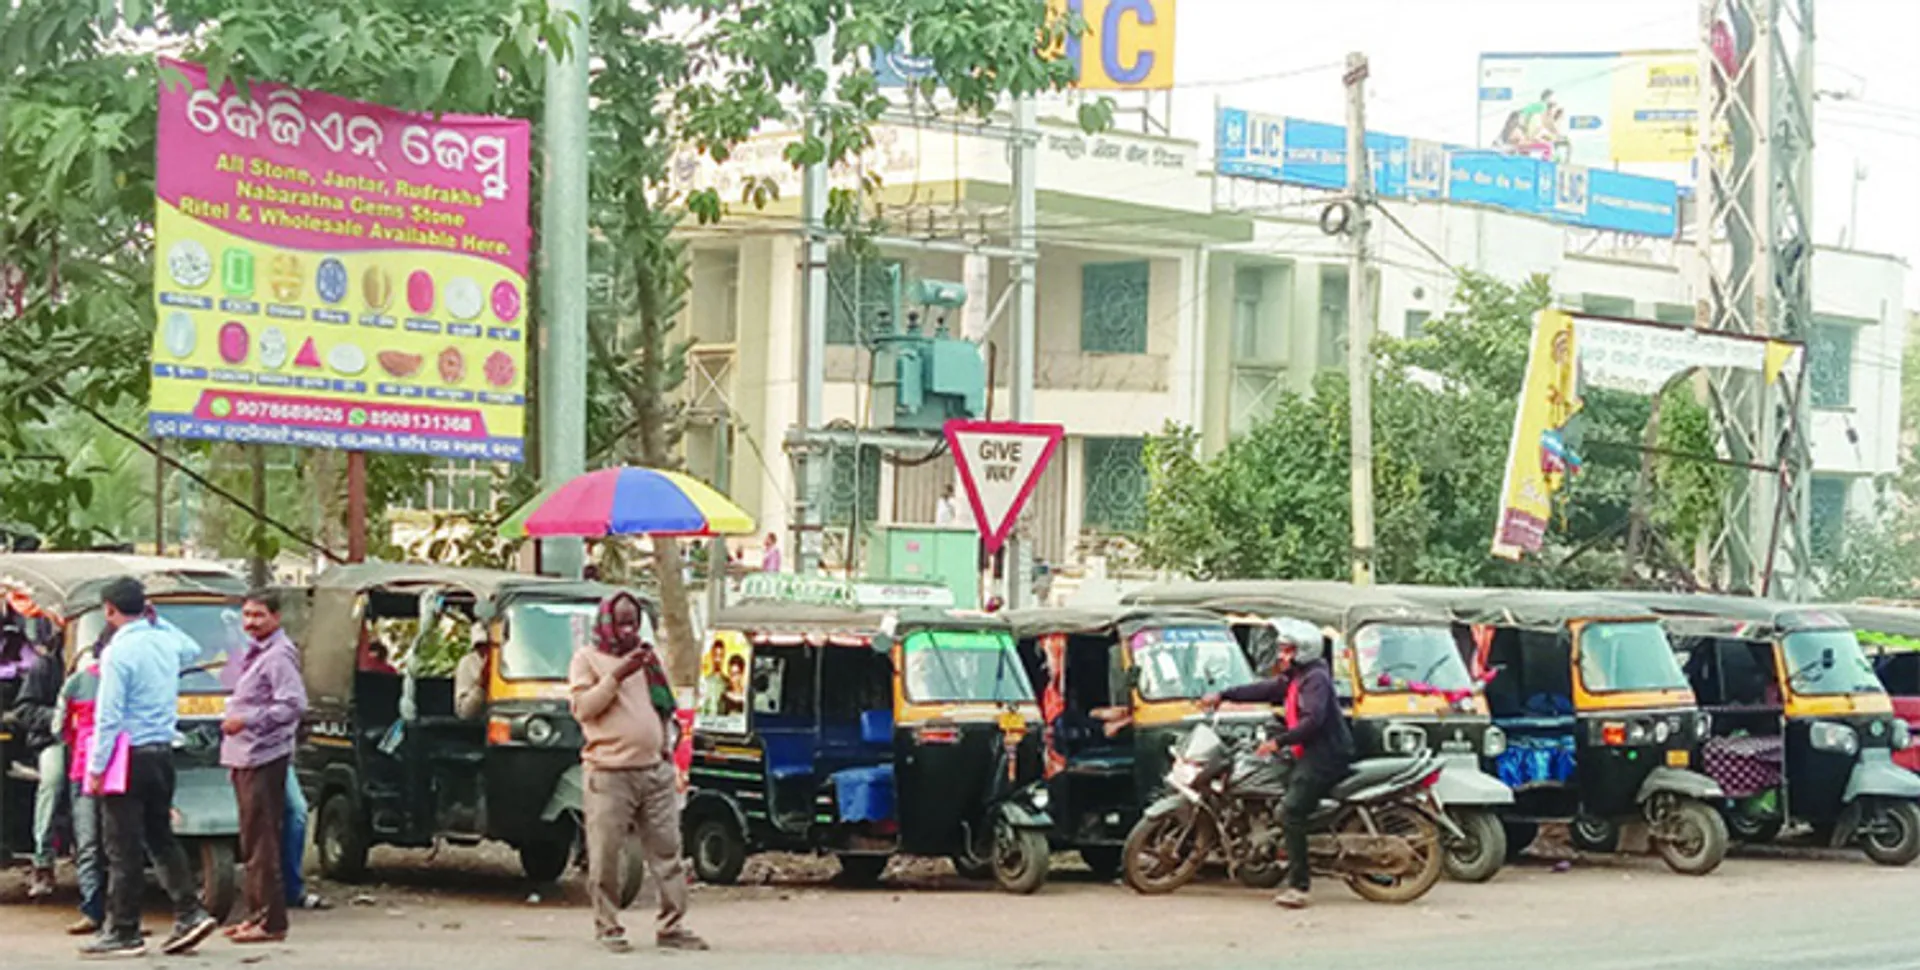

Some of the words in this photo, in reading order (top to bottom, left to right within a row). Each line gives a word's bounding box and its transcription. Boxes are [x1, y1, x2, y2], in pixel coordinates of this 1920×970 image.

[1249, 114, 1281, 158] LIC
[215, 153, 245, 173] All
[249, 158, 316, 188] Stone,
[322, 169, 390, 197] Jantar,
[395, 178, 484, 208] Rudrakhs
[1411, 142, 1441, 183] LIC
[236, 180, 344, 212] Nabaratna
[350, 196, 404, 220] Gems
[411, 203, 466, 229] Stone
[1559, 169, 1586, 205] LIC
[178, 195, 229, 220] Ritel
[236, 204, 252, 223] &
[258, 206, 364, 238] Wholesale
[369, 222, 458, 250] Available
[462, 234, 512, 256] Here.
[979, 439, 1022, 462] GIVE
[983, 464, 1018, 482] WAY
